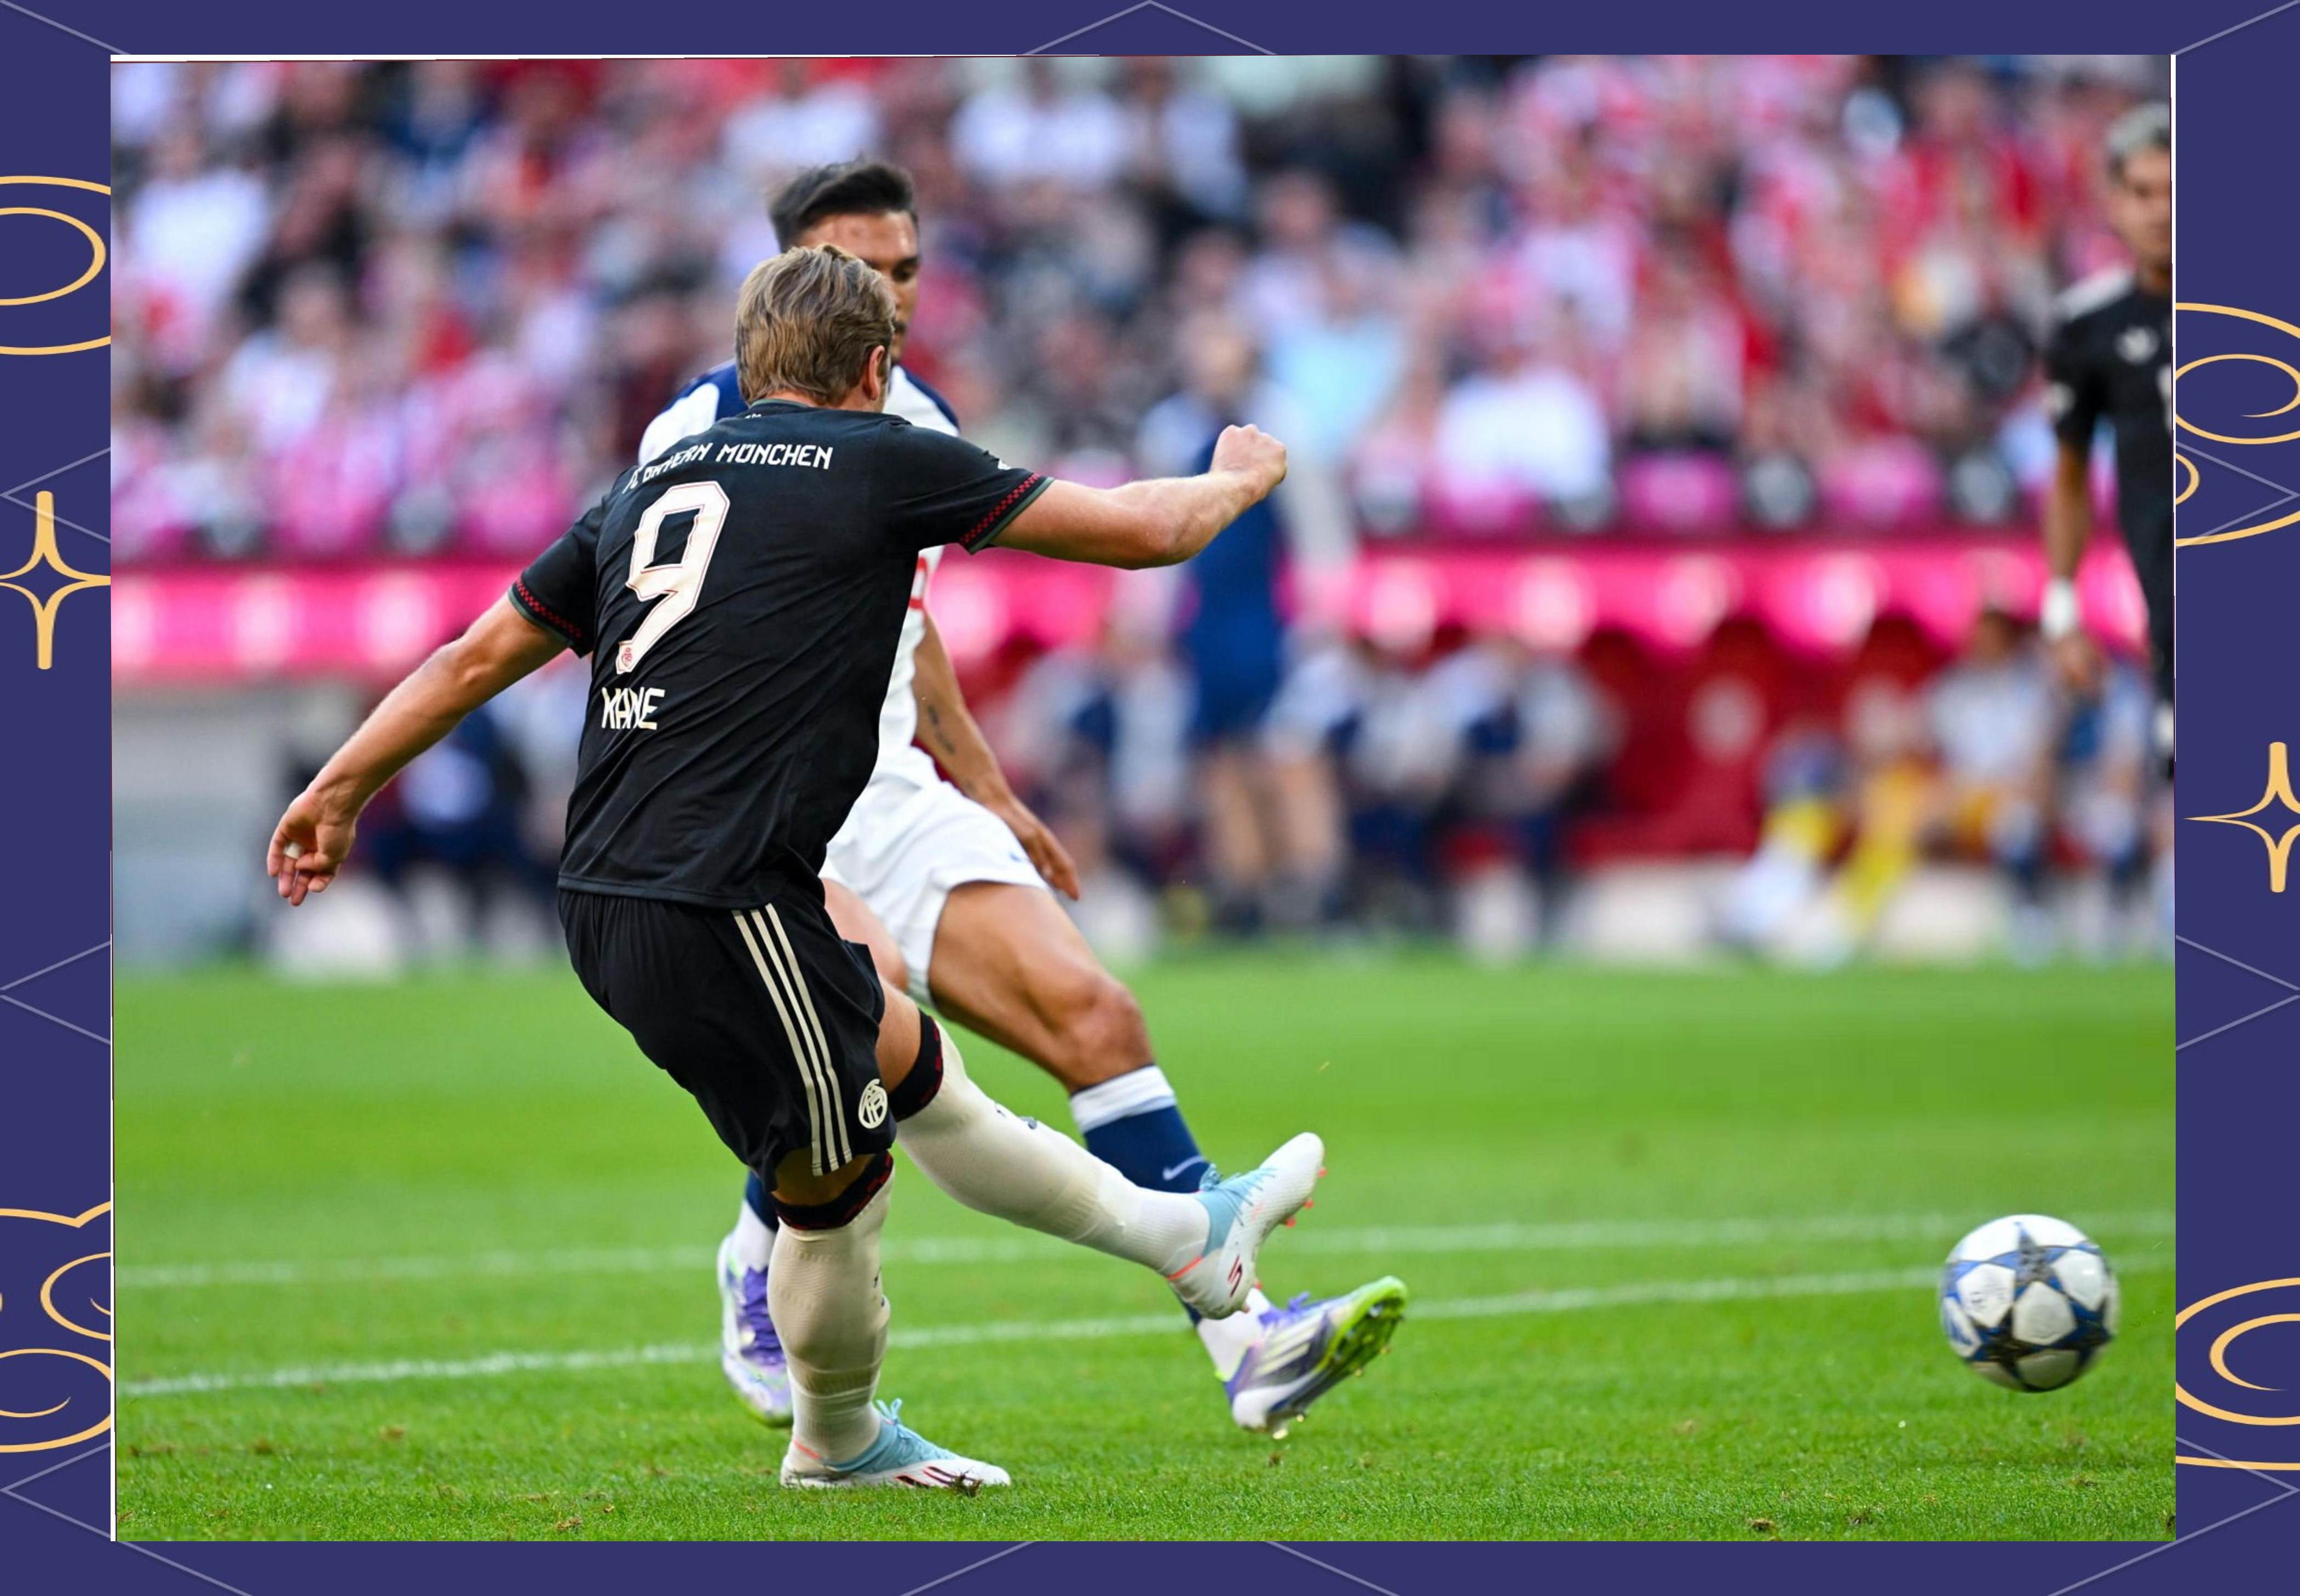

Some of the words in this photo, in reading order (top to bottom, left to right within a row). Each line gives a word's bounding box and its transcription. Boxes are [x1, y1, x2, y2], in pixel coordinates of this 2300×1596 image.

[716, 443, 833, 470] MÜNCHEN
[615, 480, 730, 675] 9
[601, 686, 666, 730] KANE
